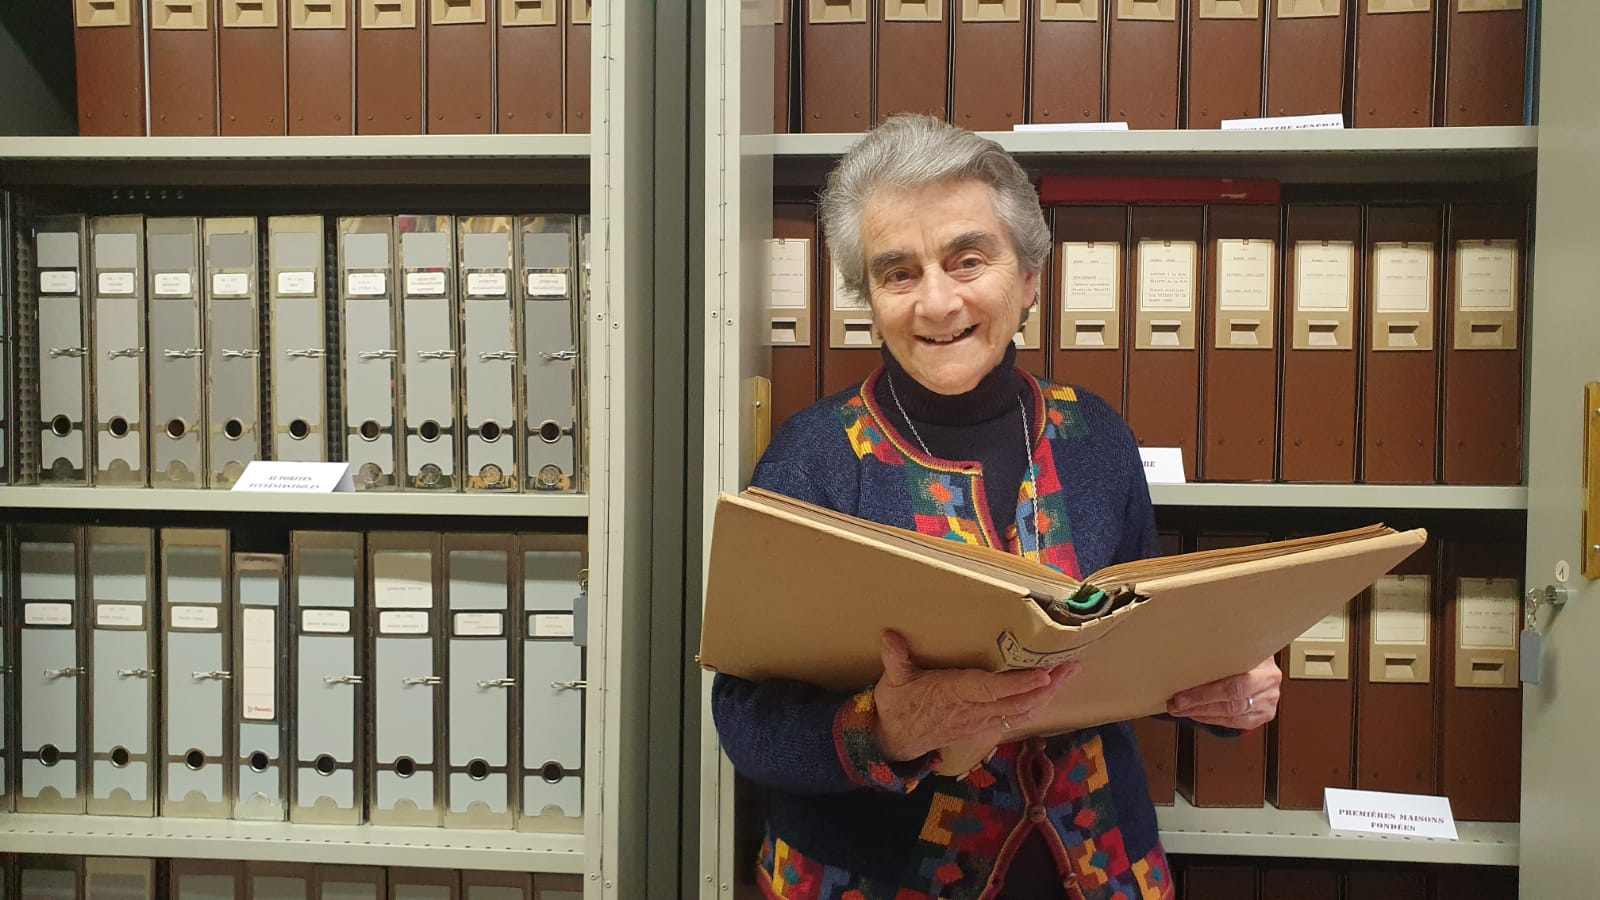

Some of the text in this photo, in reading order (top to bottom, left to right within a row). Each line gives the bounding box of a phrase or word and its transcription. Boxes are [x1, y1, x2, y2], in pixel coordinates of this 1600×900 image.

[1143, 460, 1156, 468] RE
[1399, 812, 1445, 824] MAISONS
[1370, 821, 1416, 832] FONDÉES
